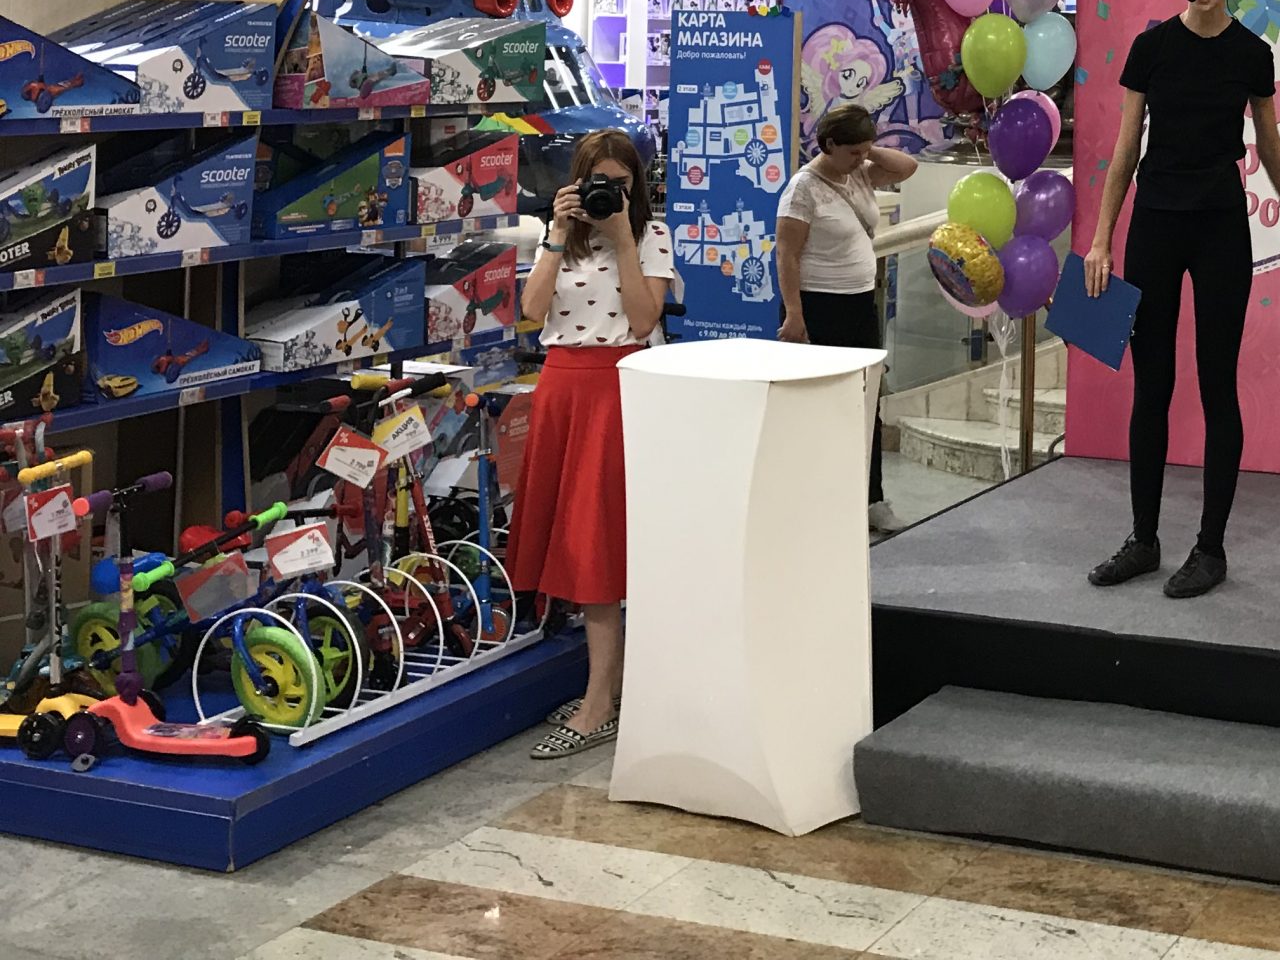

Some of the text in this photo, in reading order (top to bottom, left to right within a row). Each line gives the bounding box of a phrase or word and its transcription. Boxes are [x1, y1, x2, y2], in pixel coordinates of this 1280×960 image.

[678, 12, 726, 28] КАРТА
[224, 32, 271, 48] scooter
[502, 40, 539, 54] scooter
[677, 31, 763, 48] МАГАЗИНА
[676, 49, 747, 60] Добро пожаловать!
[52, 106, 135, 117] ТРЁХКОЛЁСНЫЙ САМОКАТ
[480, 151, 514, 168] scooter
[200, 166, 251, 184] scooter
[483, 264, 513, 283] scooter
[228, 364, 255, 375] САМОКАТ
[391, 416, 415, 440] АКЦИЯ
